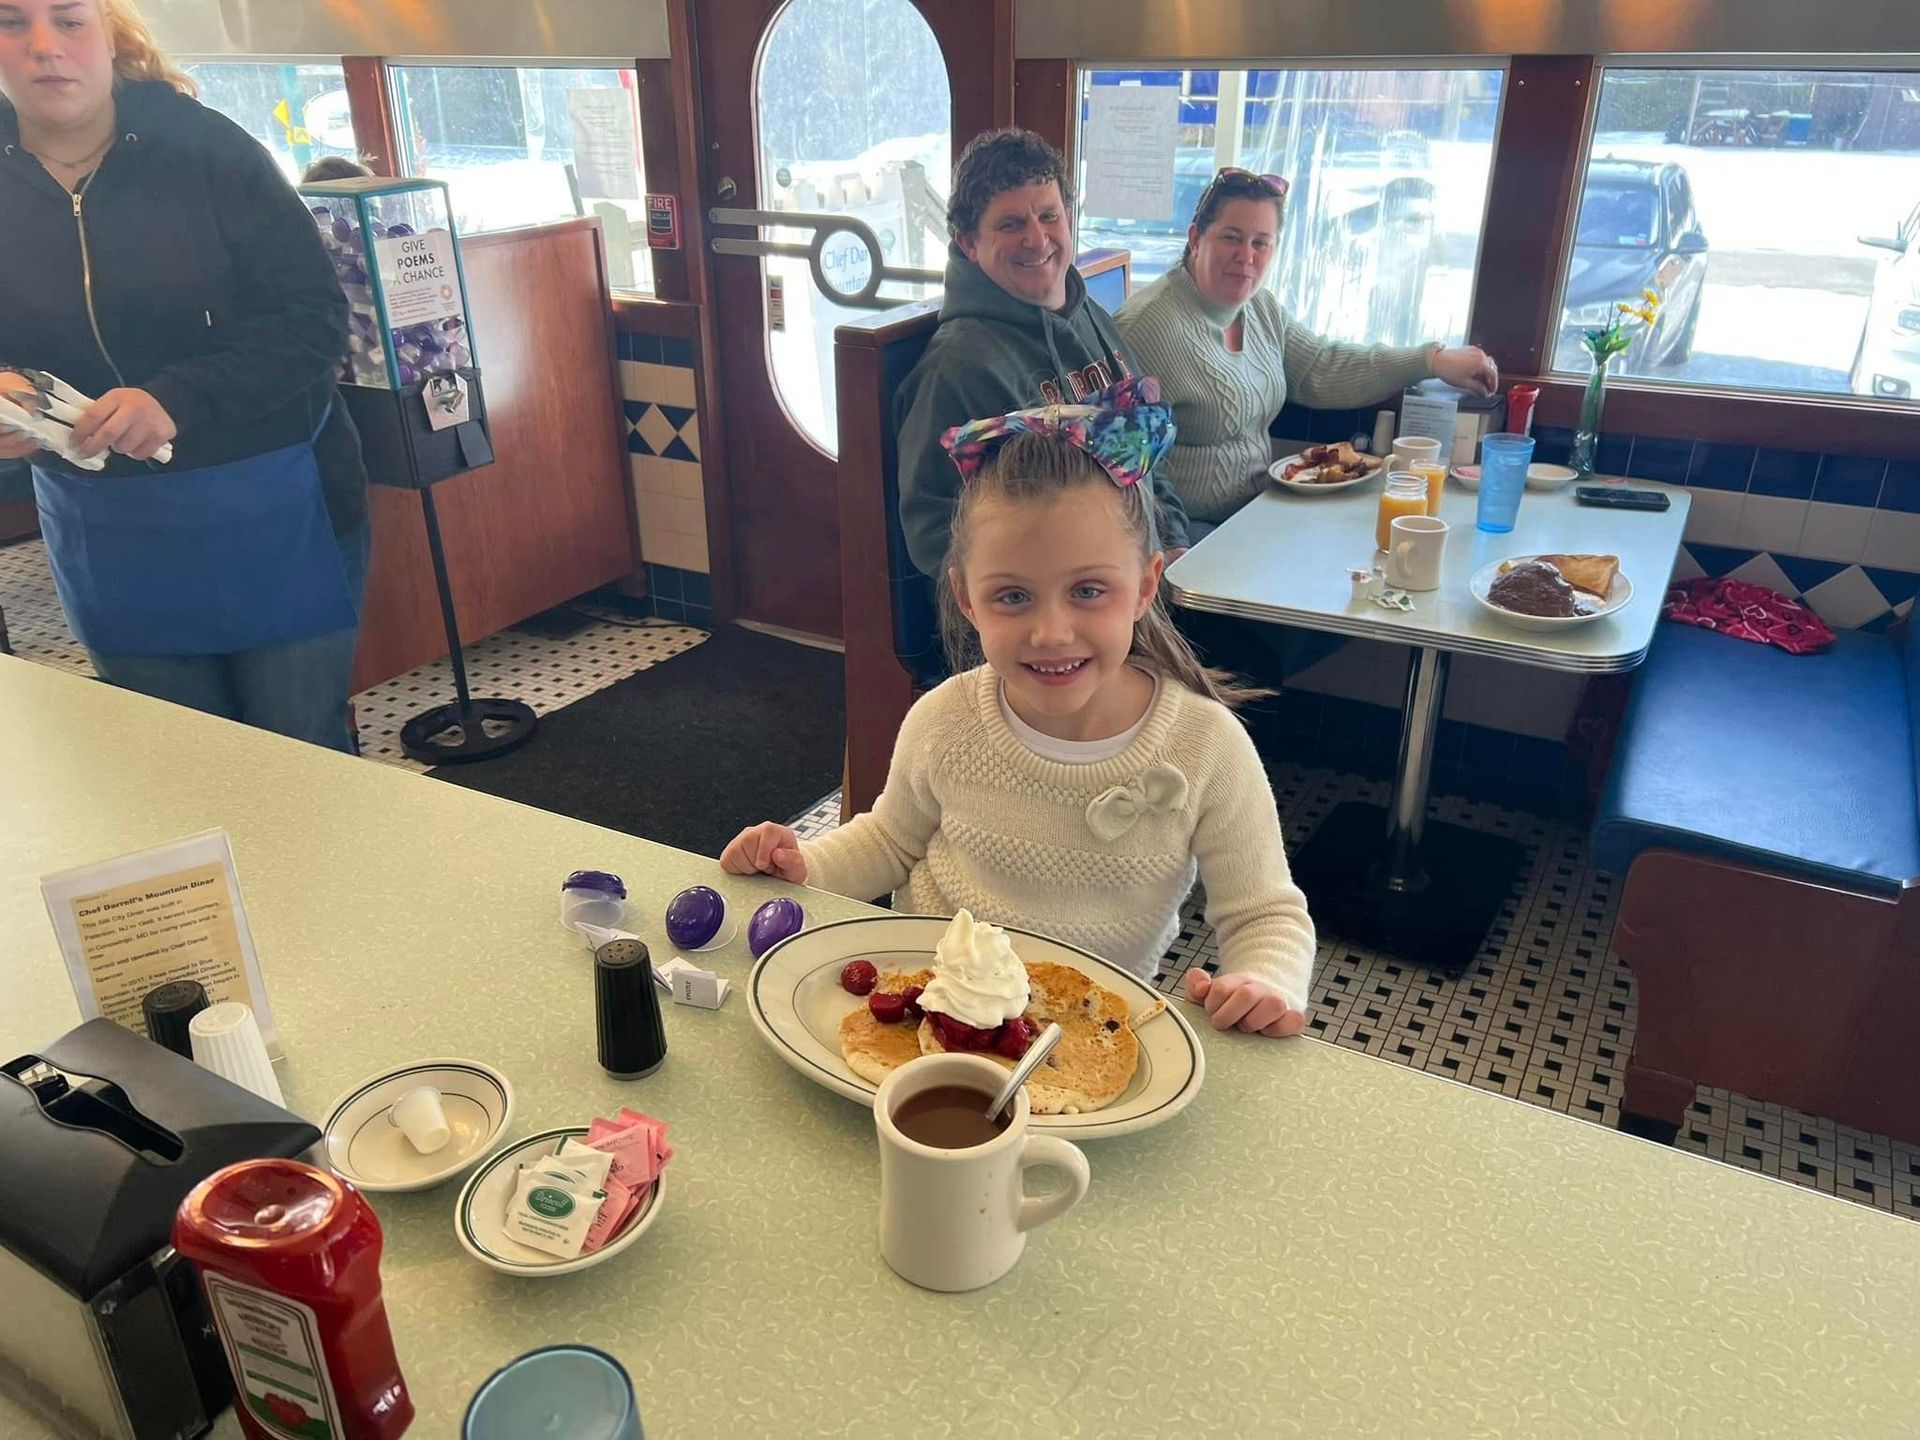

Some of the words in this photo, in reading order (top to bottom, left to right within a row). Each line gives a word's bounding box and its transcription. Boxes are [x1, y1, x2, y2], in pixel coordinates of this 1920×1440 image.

[648, 197, 672, 210] FIRE
[401, 240, 426, 253] GIVE
[397, 253, 435, 269] POEMS
[402, 266, 445, 284] CHANCE
[78, 906, 101, 917] Chef
[103, 896, 143, 911] Darrell's
[145, 885, 188, 900] Mountain
[190, 878, 215, 889] Diner
[117, 957, 130, 965] and
[170, 941, 186, 950] Chef
[168, 965, 190, 974] moved
